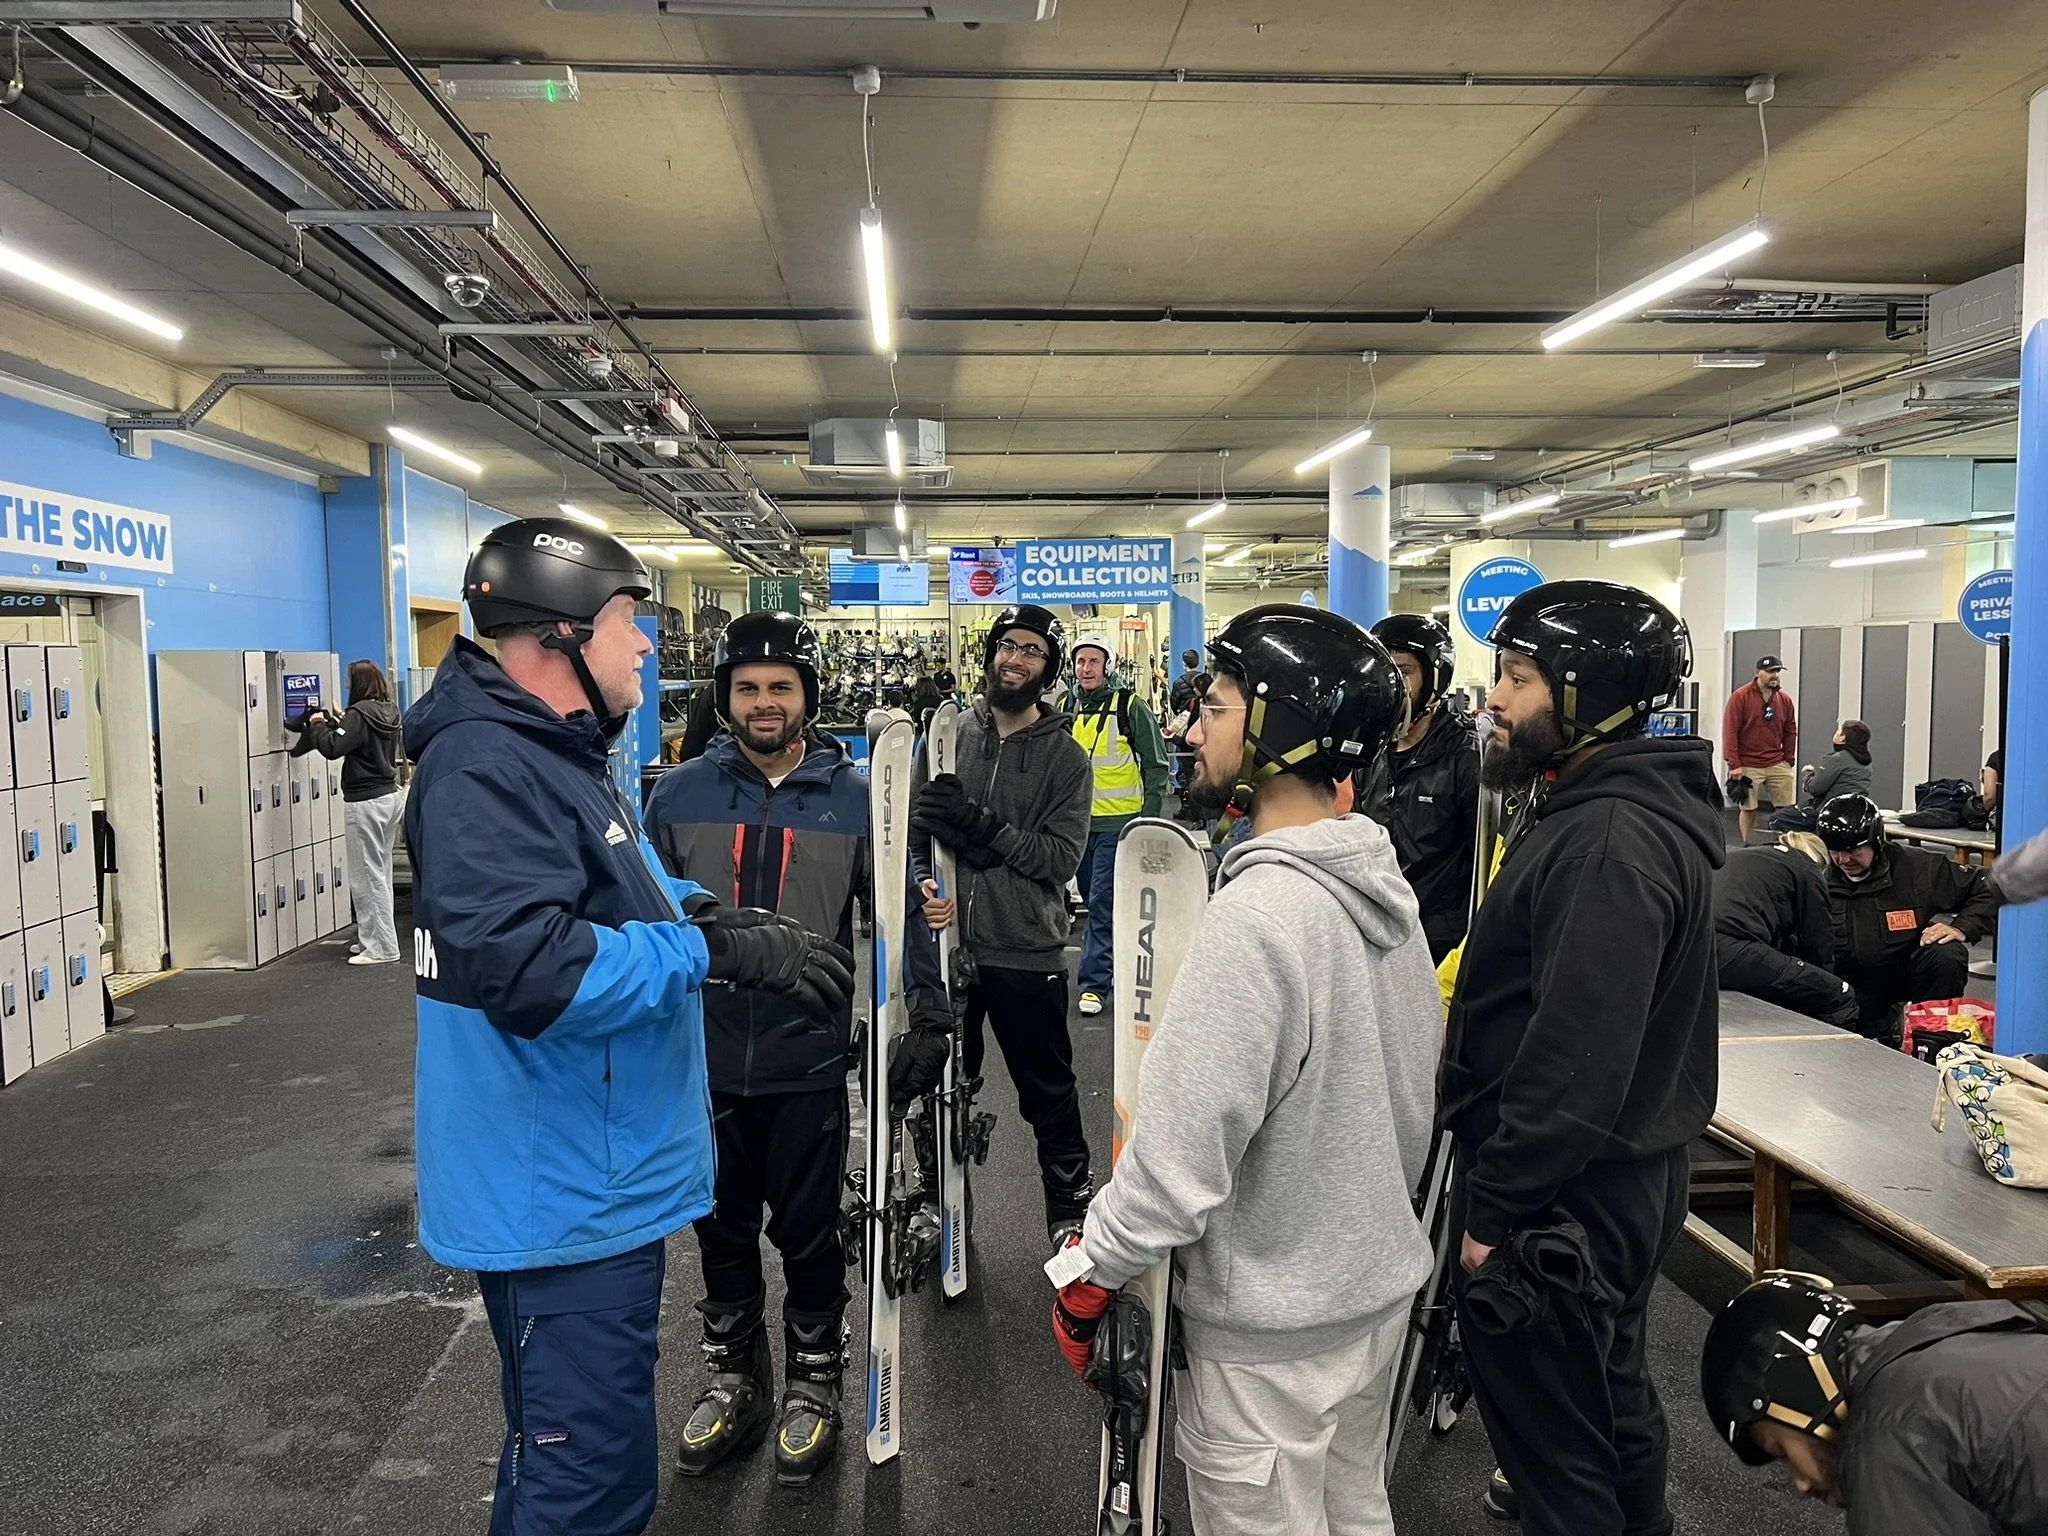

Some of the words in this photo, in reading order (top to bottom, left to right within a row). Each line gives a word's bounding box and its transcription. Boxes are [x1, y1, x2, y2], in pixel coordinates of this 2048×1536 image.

[0, 494, 63, 547] THE
[72, 508, 167, 562] SNOW
[1025, 543, 1164, 567] EQUIPMENT
[1021, 566, 1168, 587] COLLECTION
[1480, 565, 1528, 578] MEETING
[761, 580, 783, 595] FIRE
[1100, 590, 1125, 598] BOOTS
[1134, 589, 1168, 597] HELMETS
[760, 595, 783, 610] EXIT
[1512, 637, 1538, 651] HEAD
[287, 676, 317, 690] RENT
[883, 764, 892, 846] HEAD
[1134, 886, 1157, 1022] HEAD
[952, 1220, 960, 1273] AMBITION
[879, 1366, 892, 1433] AMBITION
